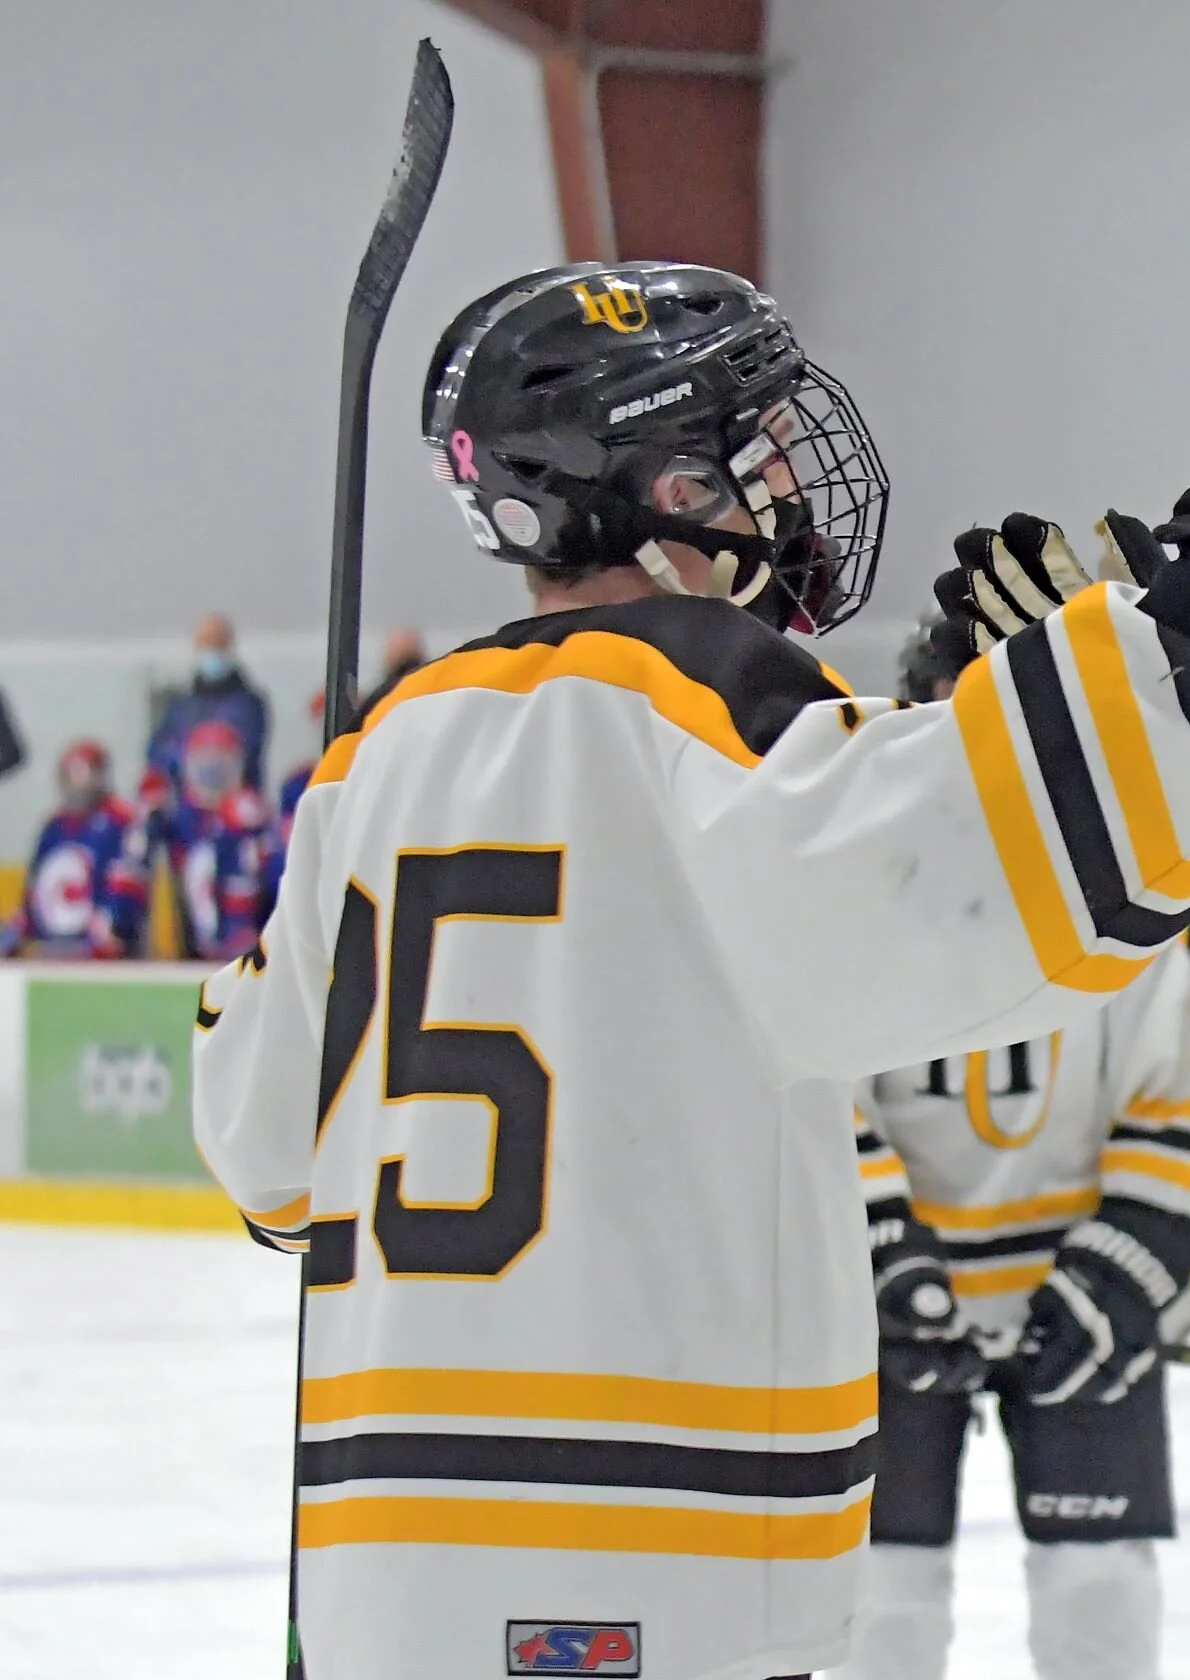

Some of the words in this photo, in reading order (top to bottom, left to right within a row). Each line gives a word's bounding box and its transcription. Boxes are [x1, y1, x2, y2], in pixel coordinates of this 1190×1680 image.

[609, 381, 693, 425] BAUER
[1026, 1494, 1130, 1520] CCM
[532, 1626, 635, 1671] SP
